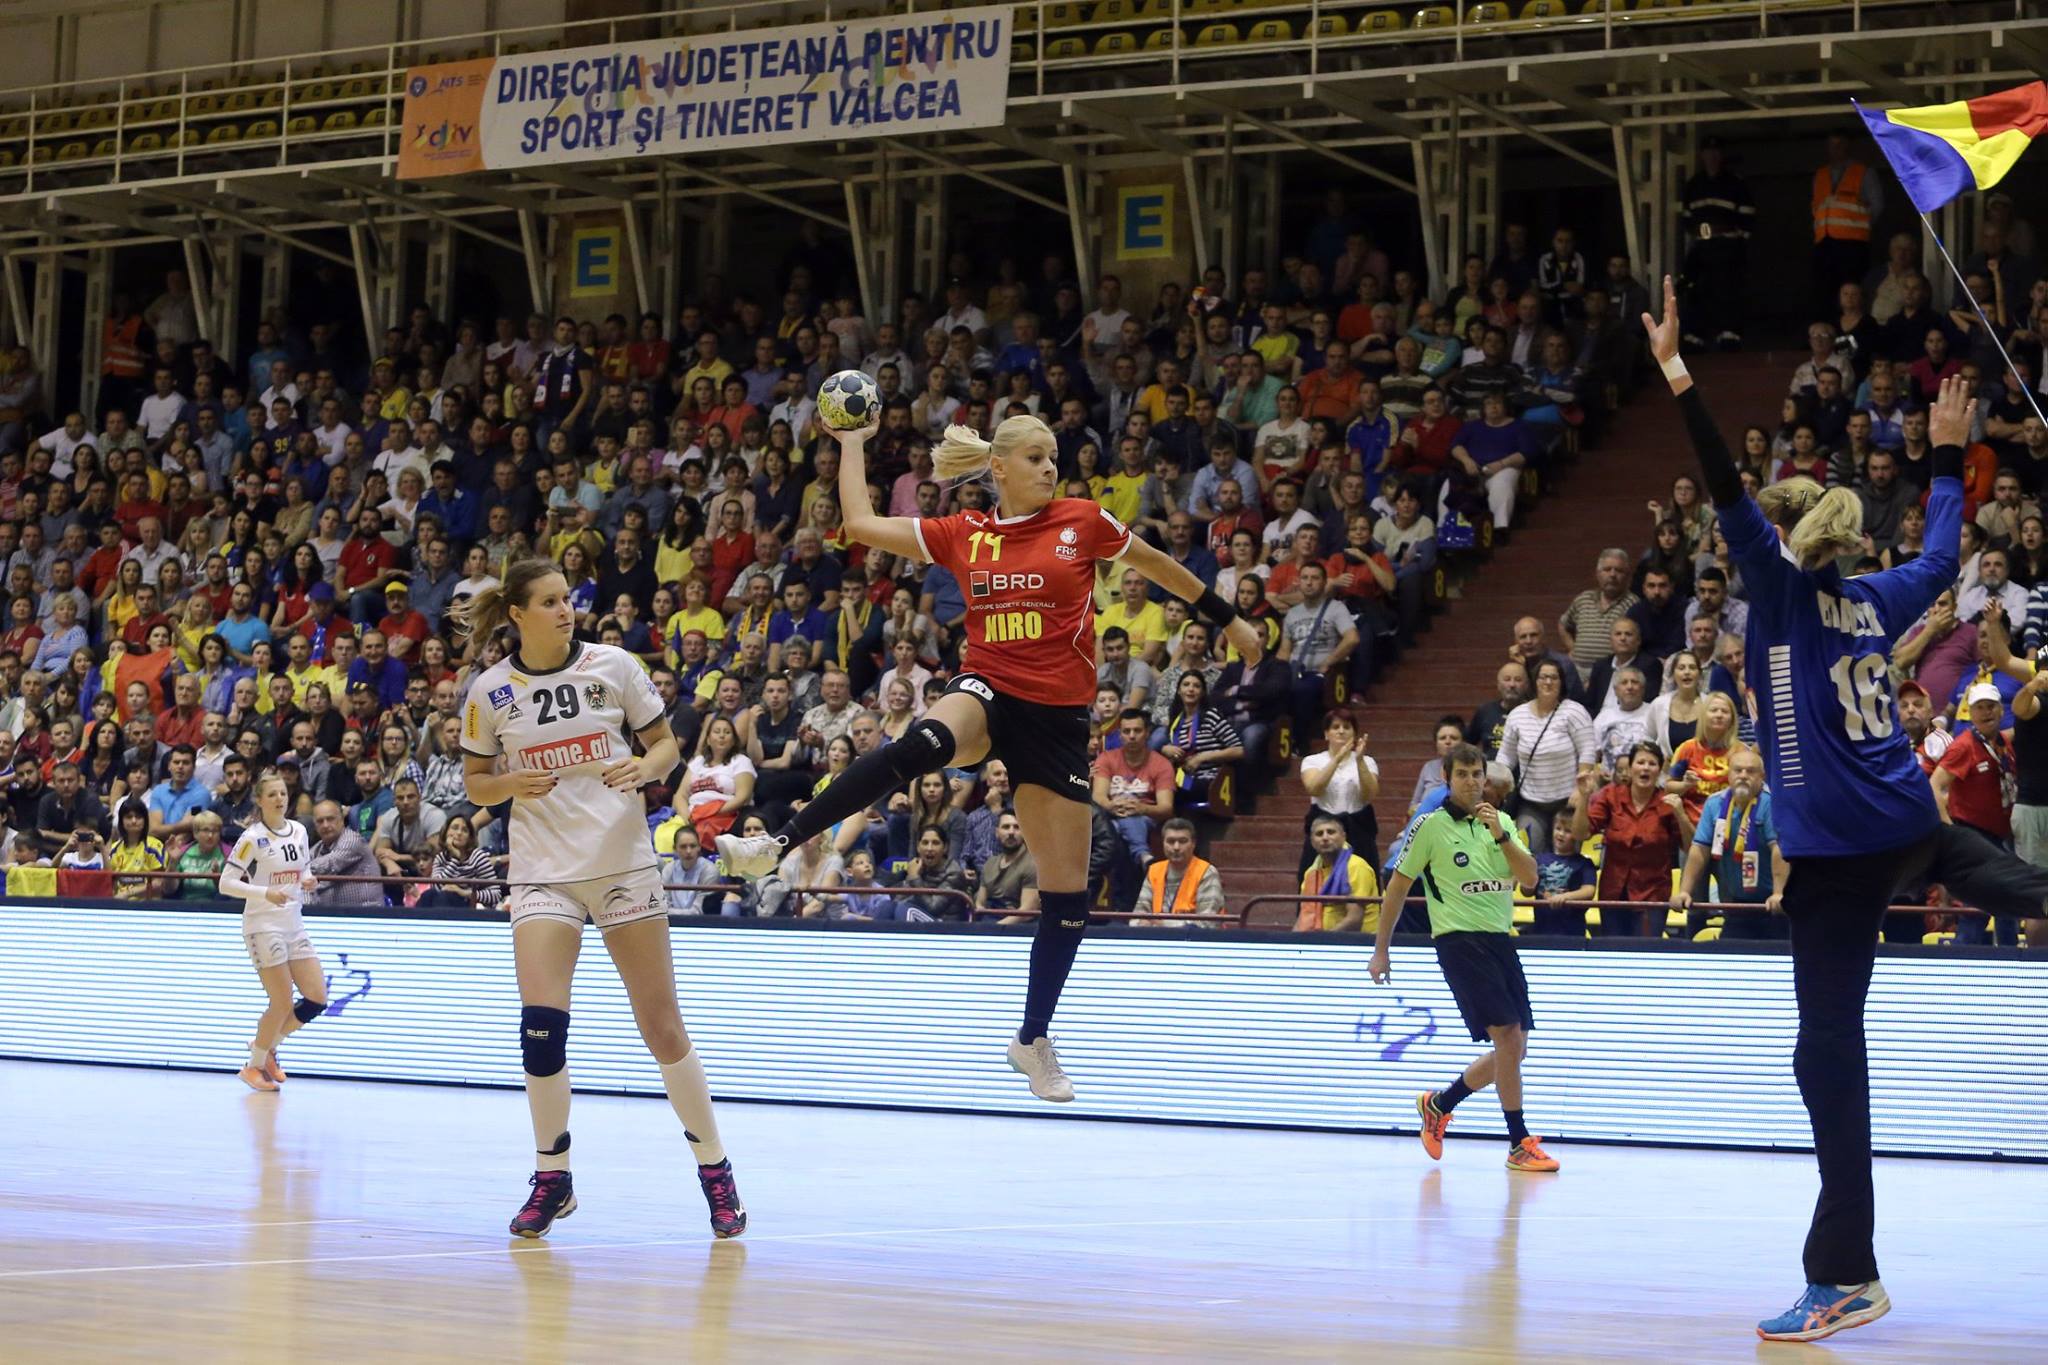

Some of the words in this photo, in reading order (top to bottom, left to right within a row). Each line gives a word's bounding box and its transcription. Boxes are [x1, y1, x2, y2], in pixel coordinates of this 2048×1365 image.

[863, 19, 1001, 70] PENTRU
[521, 109, 625, 154] SPORT
[677, 92, 818, 140] TINERET
[829, 79, 961, 127] VÂLCEA
[1125, 195, 1164, 249] E
[576, 236, 610, 287] E
[993, 574, 1044, 590] BRD
[1434, 568, 1445, 598] 8
[533, 684, 580, 726] 29
[1335, 675, 1345, 703] 6
[1830, 653, 1893, 740] 16
[1280, 728, 1290, 758] 5
[1220, 776, 1231, 806] 4
[281, 844, 298, 862] 18
